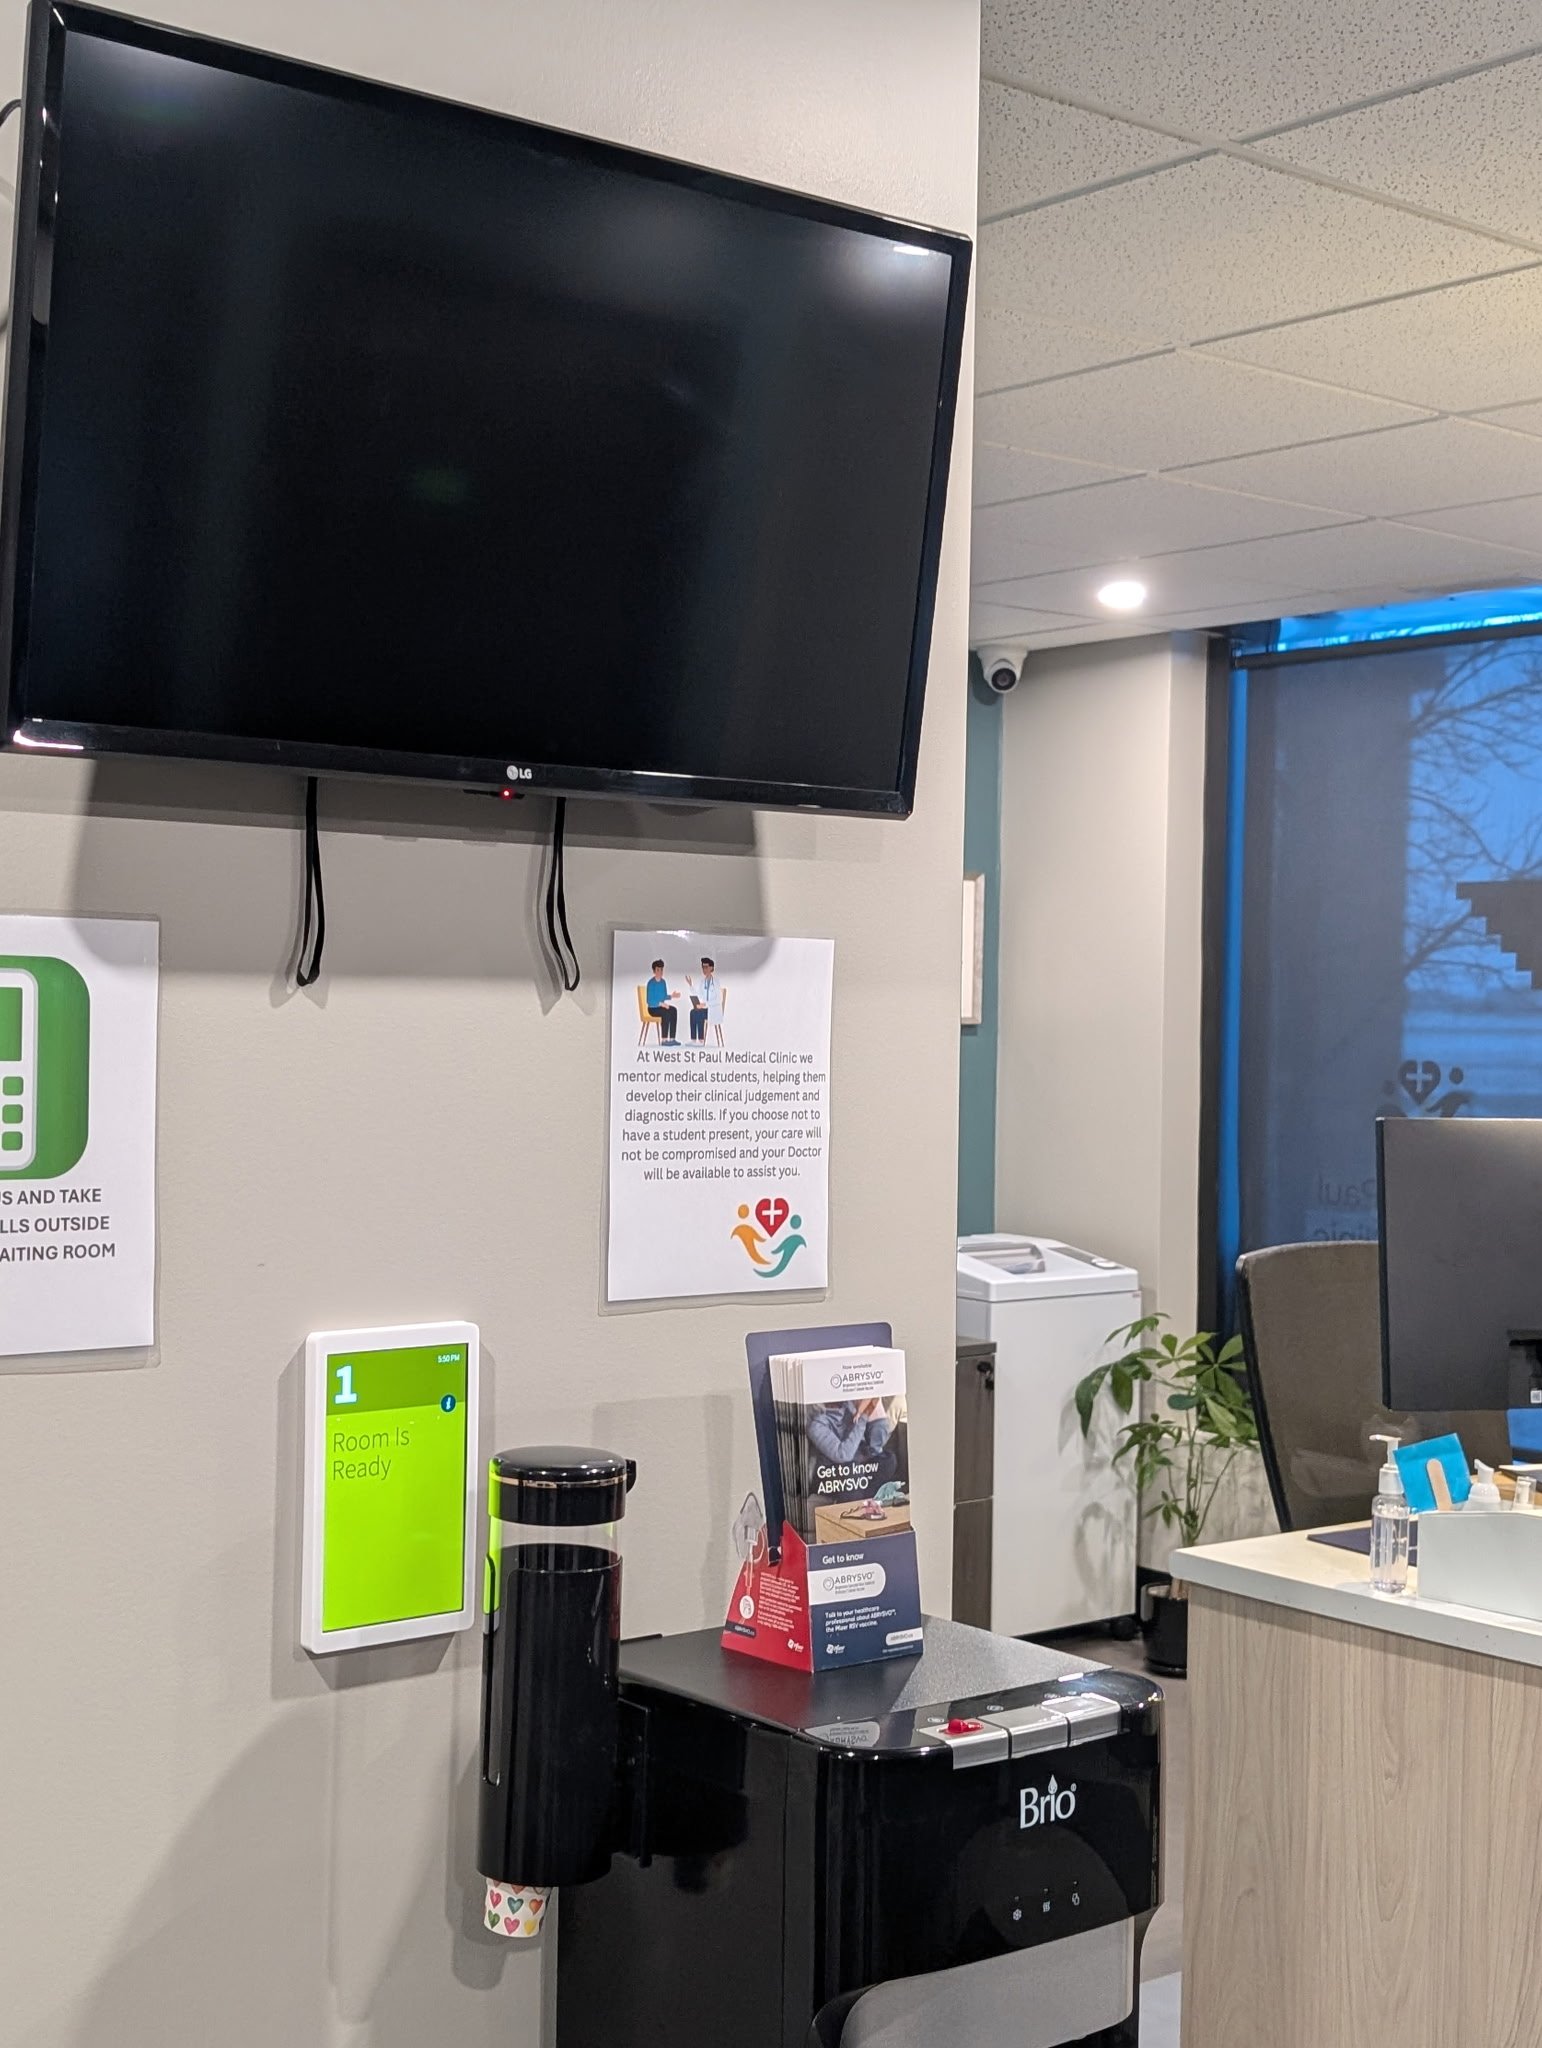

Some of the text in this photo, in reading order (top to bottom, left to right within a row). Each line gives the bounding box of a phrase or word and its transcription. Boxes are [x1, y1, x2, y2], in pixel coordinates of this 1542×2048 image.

[520, 768, 532, 779] LG
[637, 1051, 813, 1064] At West St Paul Medical Clinic we
[618, 1070, 826, 1085] mentor medical students, helping them
[626, 1090, 820, 1104] develop their clinical judgement and
[624, 1109, 820, 1124] diagnostic skills. If you choose not to
[622, 1127, 822, 1143] have a student present, your care will
[622, 1146, 822, 1162] not be compromised and your Doctor
[644, 1166, 800, 1180] will be available to assist you.
[0, 1188, 102, 1205] S AND TAKE
[34, 1216, 110, 1232] OUTSIDE
[63, 1243, 115, 1259] ROOM
[450, 1354, 460, 1362] PM
[334, 1365, 358, 1404] 1
[333, 1427, 410, 1452] Room Is
[333, 1455, 392, 1481] Ready
[816, 1462, 878, 1478] Get to know
[822, 1556, 836, 1564] Get
